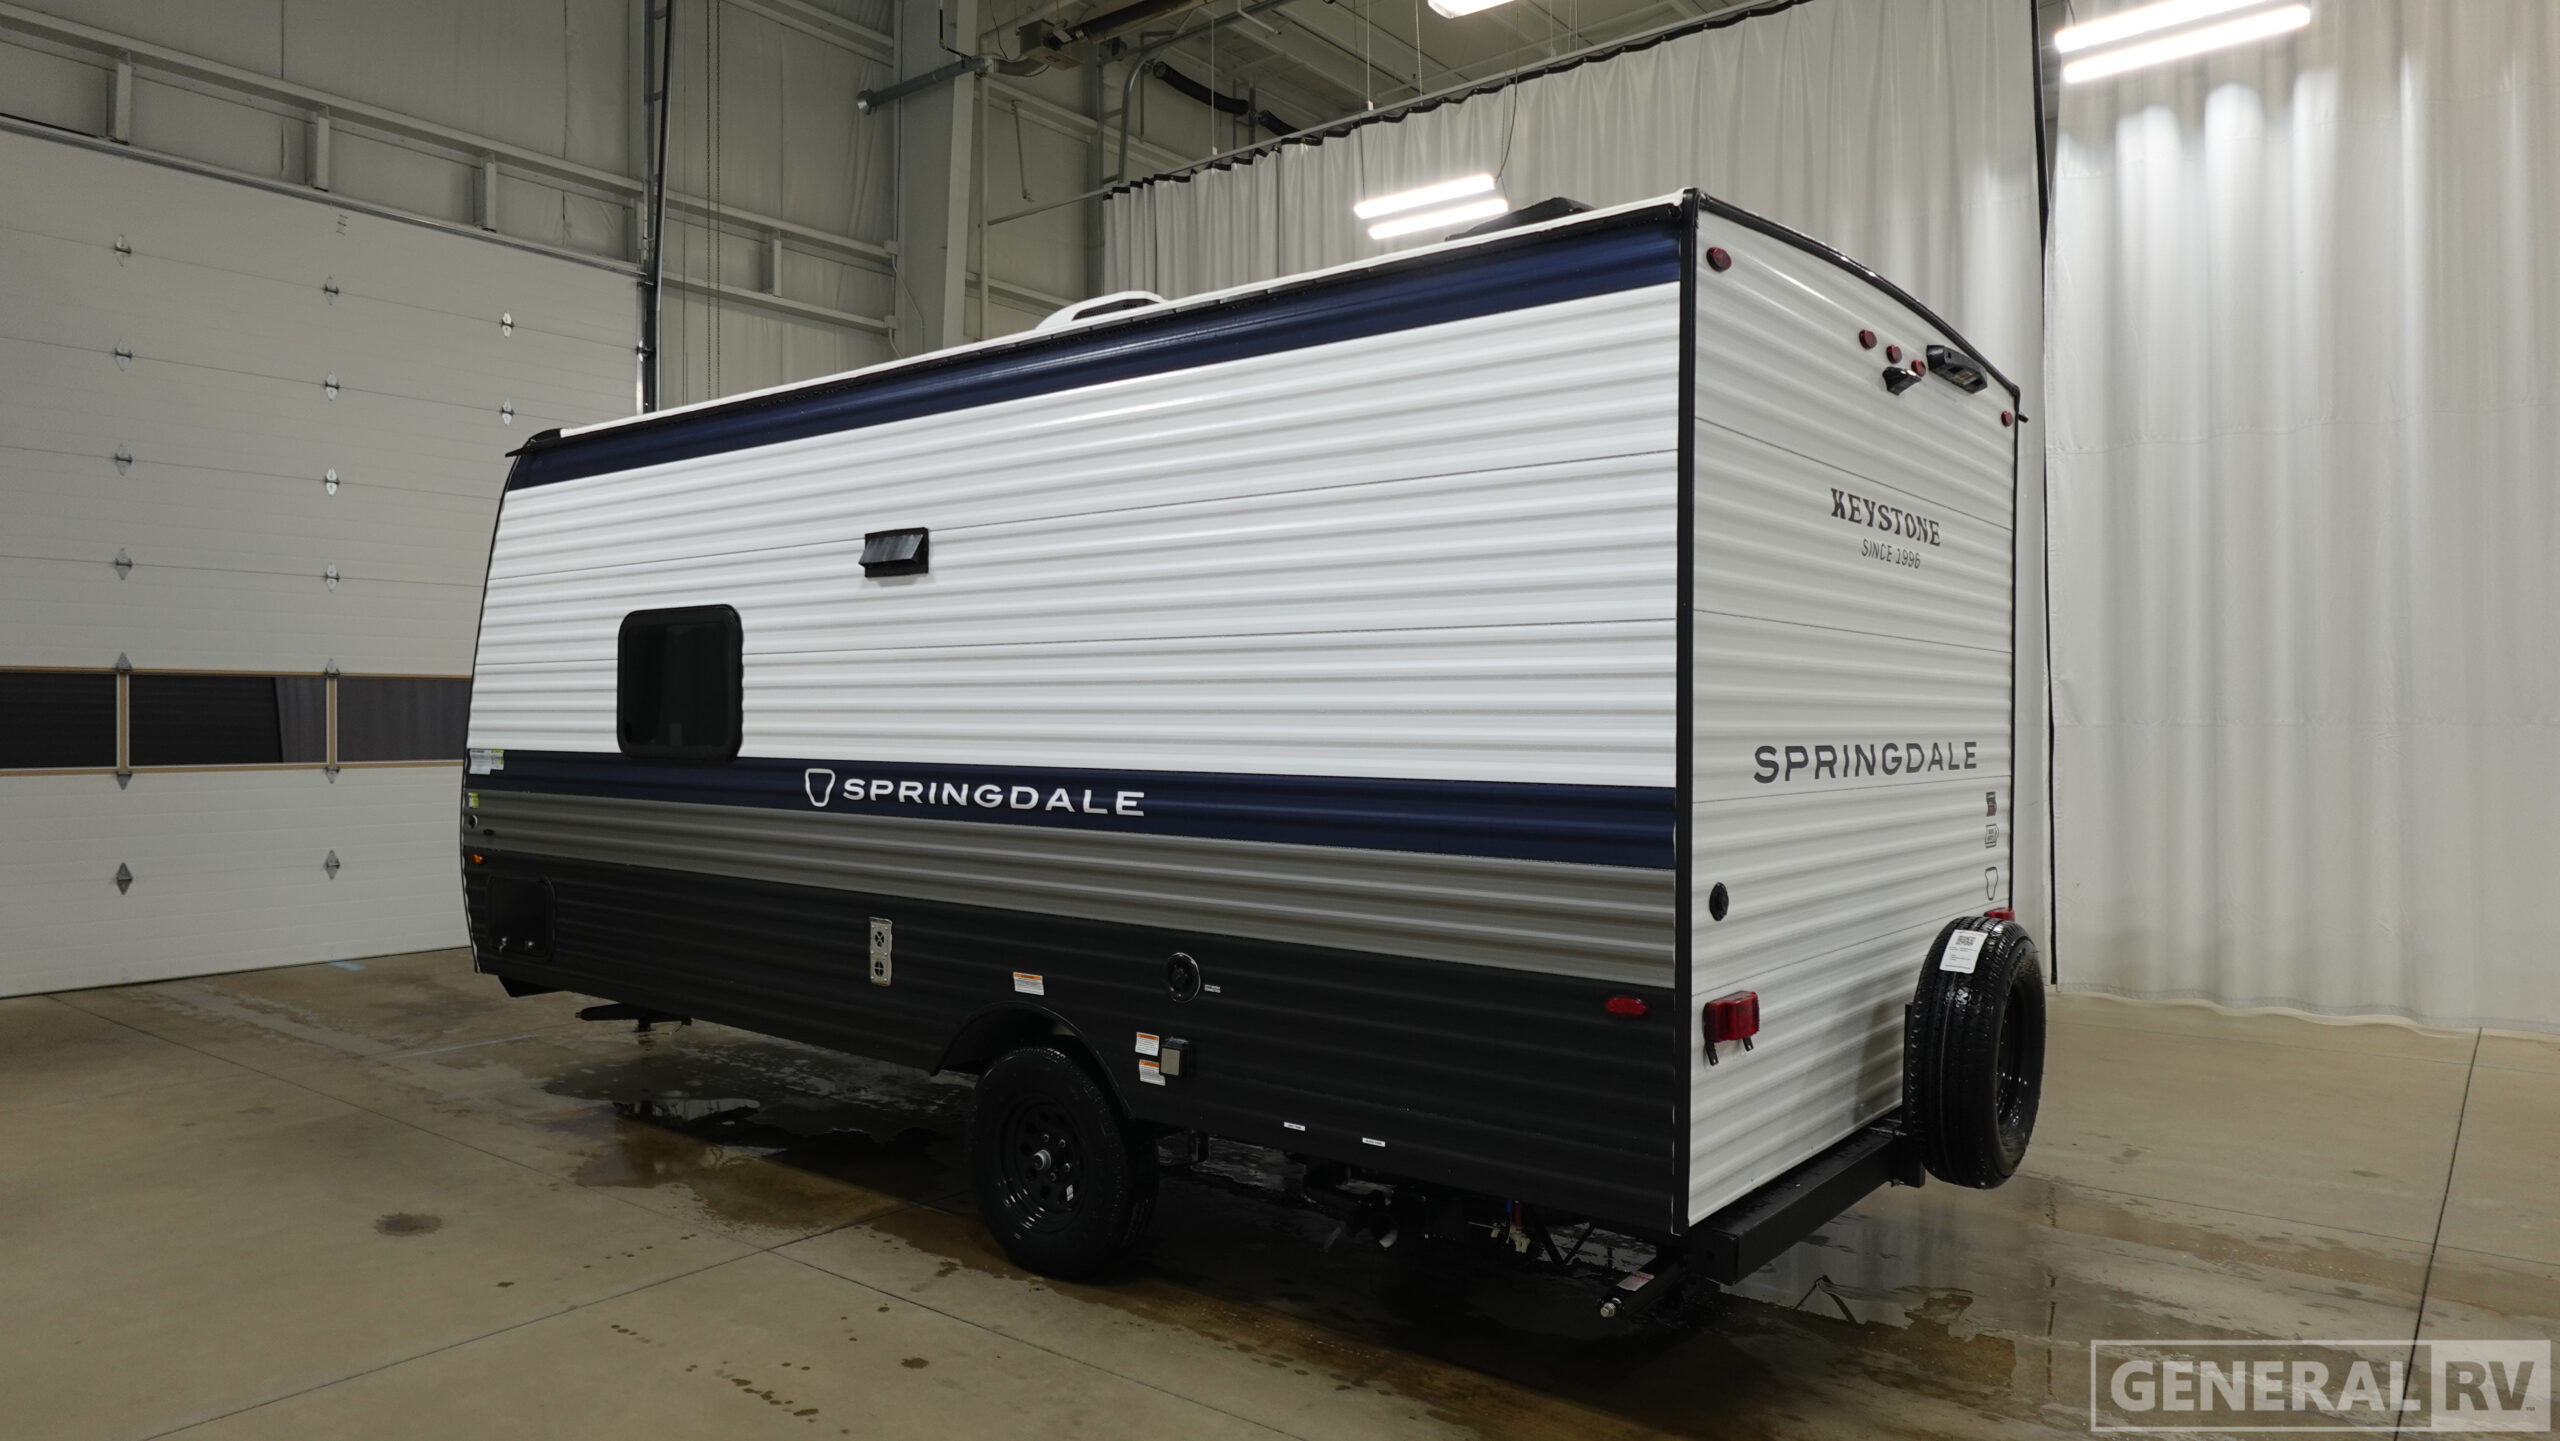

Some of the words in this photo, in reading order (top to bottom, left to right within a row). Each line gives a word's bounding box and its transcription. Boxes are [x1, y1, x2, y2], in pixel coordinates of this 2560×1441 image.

[1831, 488, 1941, 547] KEYSTONE
[1861, 539, 1892, 563] SINCE
[1895, 548, 1921, 569] 1996
[1754, 741, 1978, 784] SPRINGDALE
[843, 778, 1145, 817] SPRINGDALE
